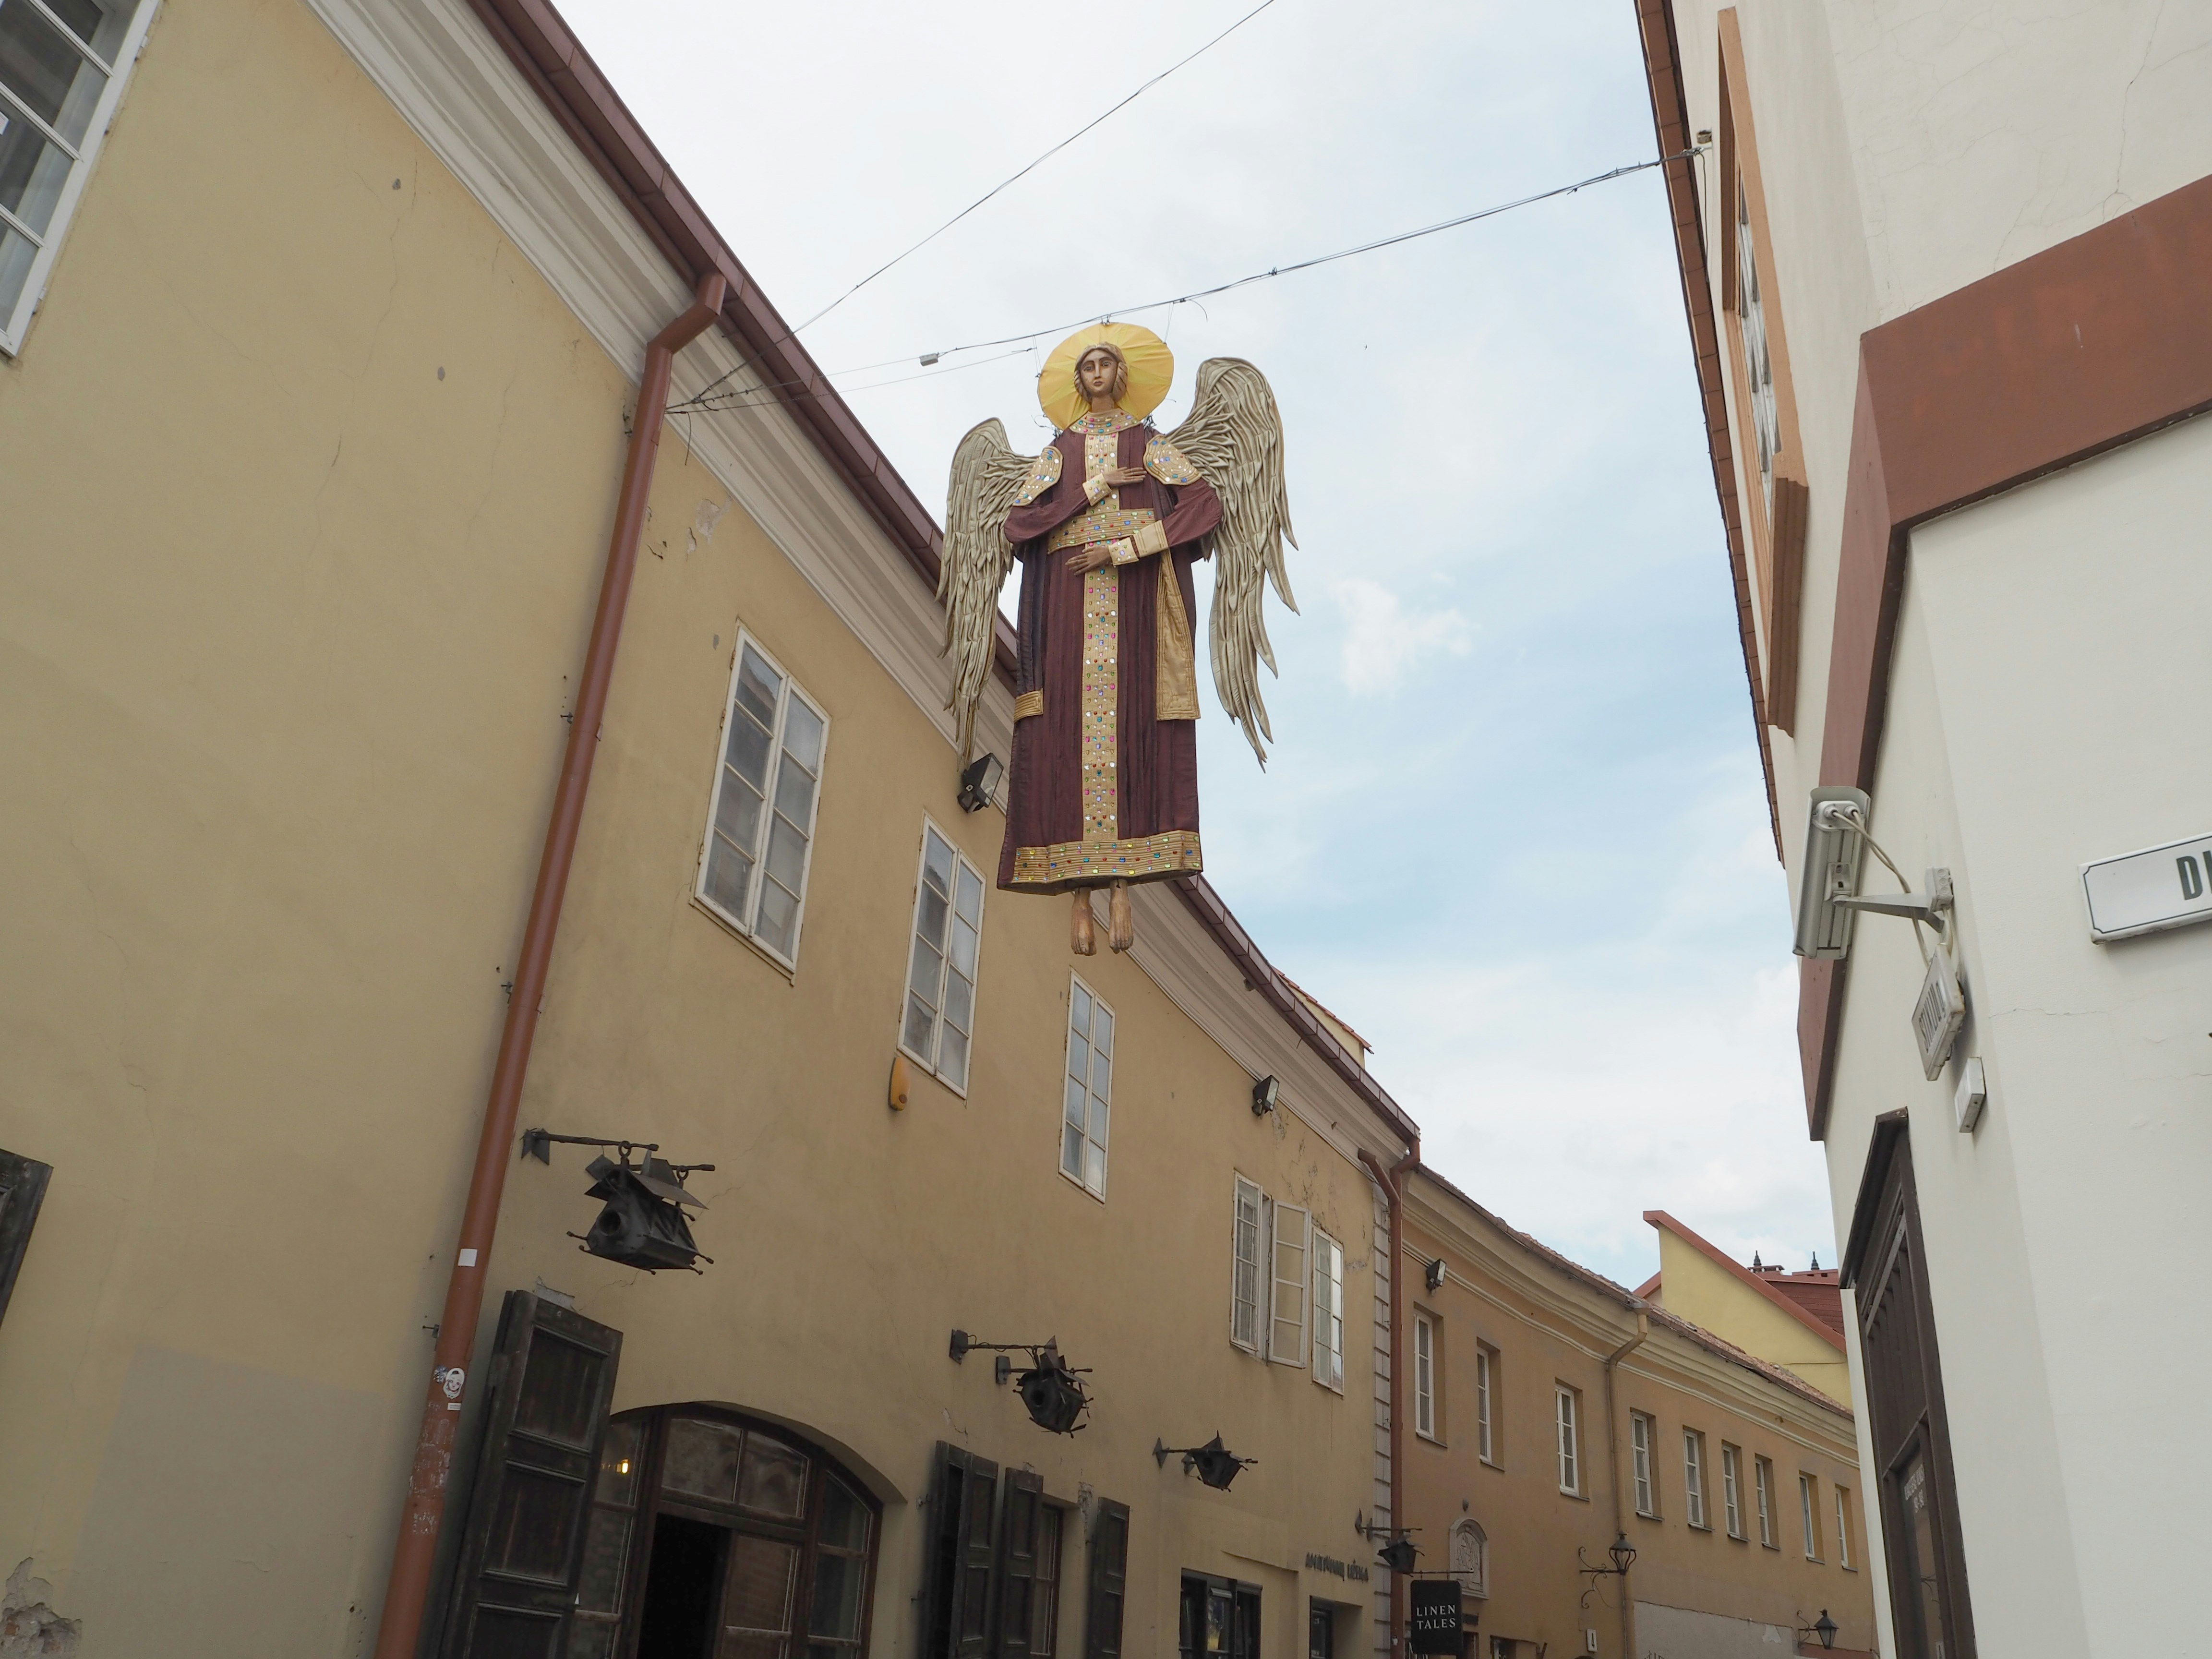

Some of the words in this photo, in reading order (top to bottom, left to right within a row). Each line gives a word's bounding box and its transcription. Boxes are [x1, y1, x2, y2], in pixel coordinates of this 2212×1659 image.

[1416, 1604, 1456, 1617] LINEN
[1417, 1617, 1456, 1630] TALES
[1591, 1632, 1595, 1649] 4
